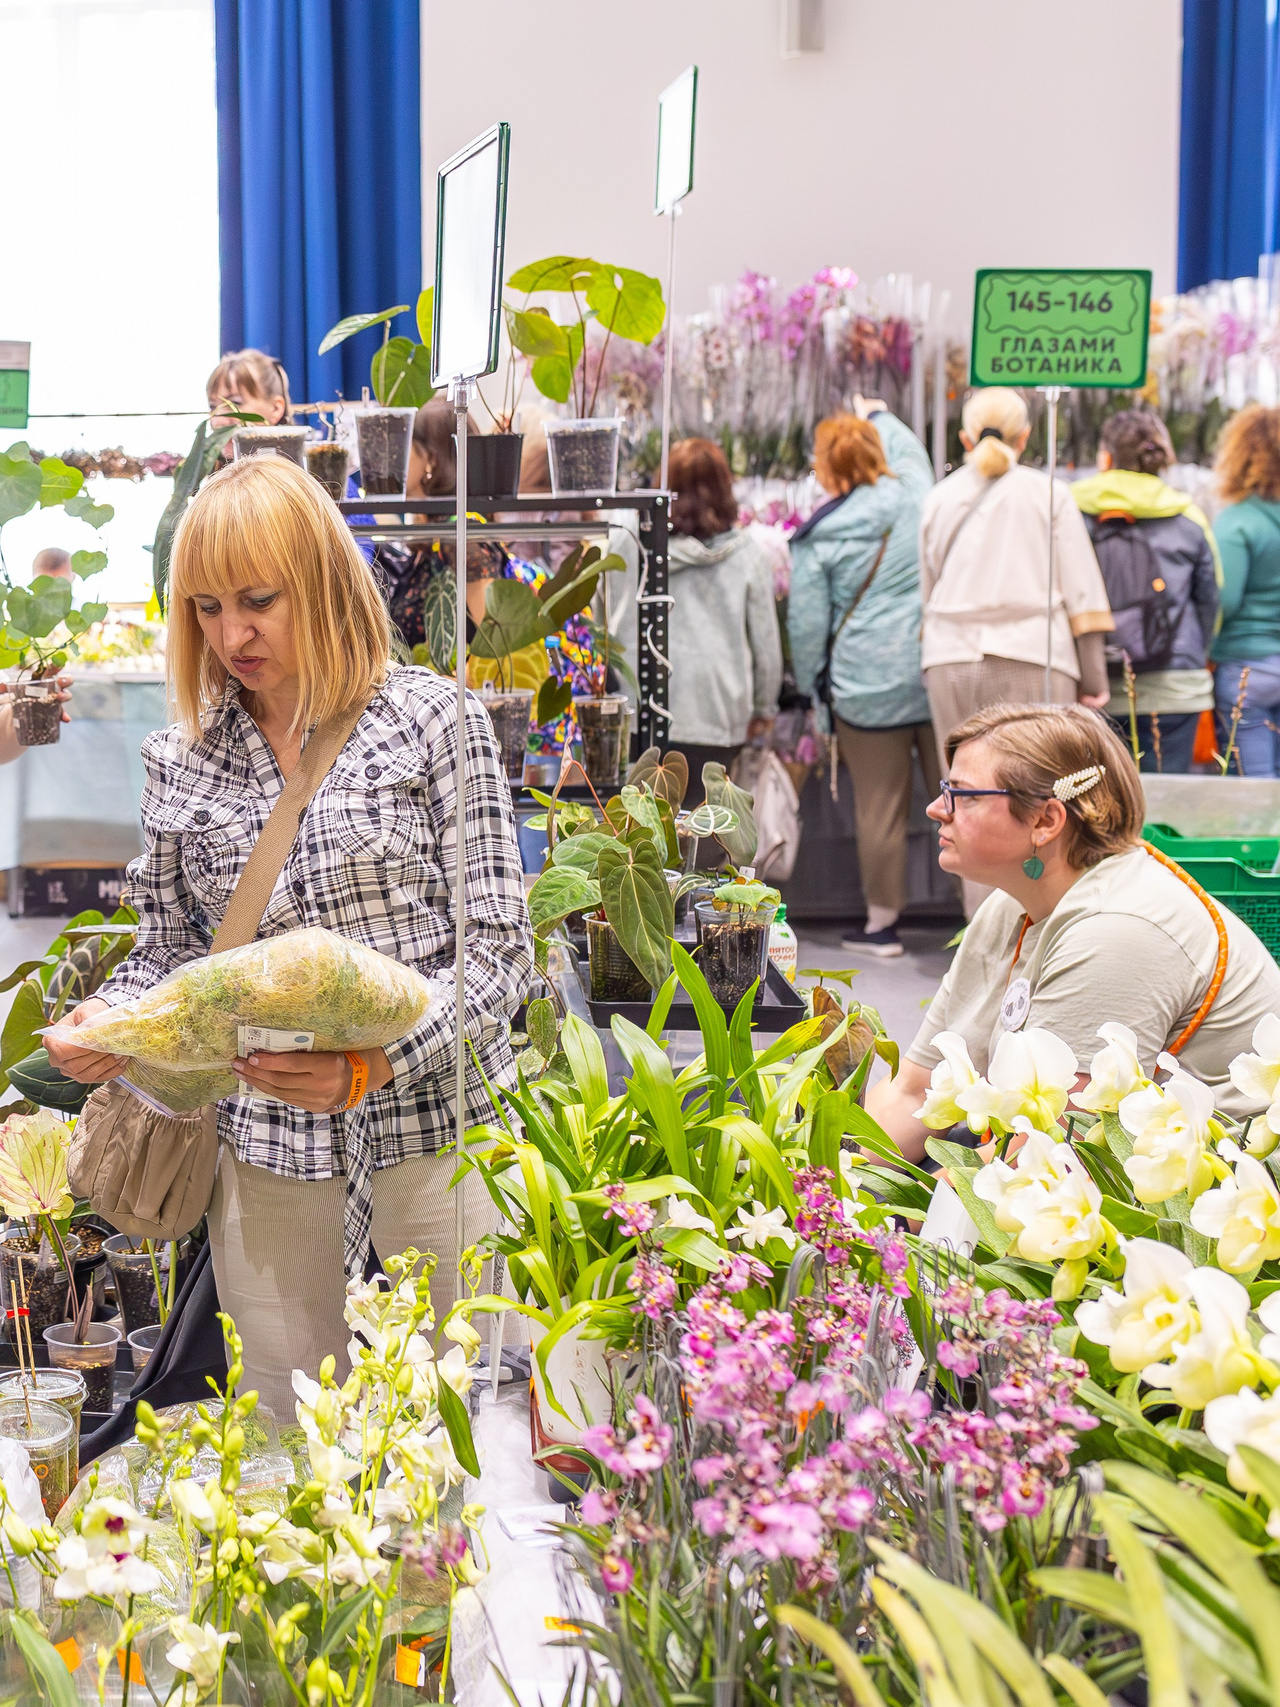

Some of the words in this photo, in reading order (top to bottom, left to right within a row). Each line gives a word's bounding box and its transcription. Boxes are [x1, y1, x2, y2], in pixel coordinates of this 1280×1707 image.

[1006, 290, 1113, 314] 145-146
[999, 336, 1117, 354] ГЛАЗАМИ
[990, 356, 1123, 374] БОТАНИКА
